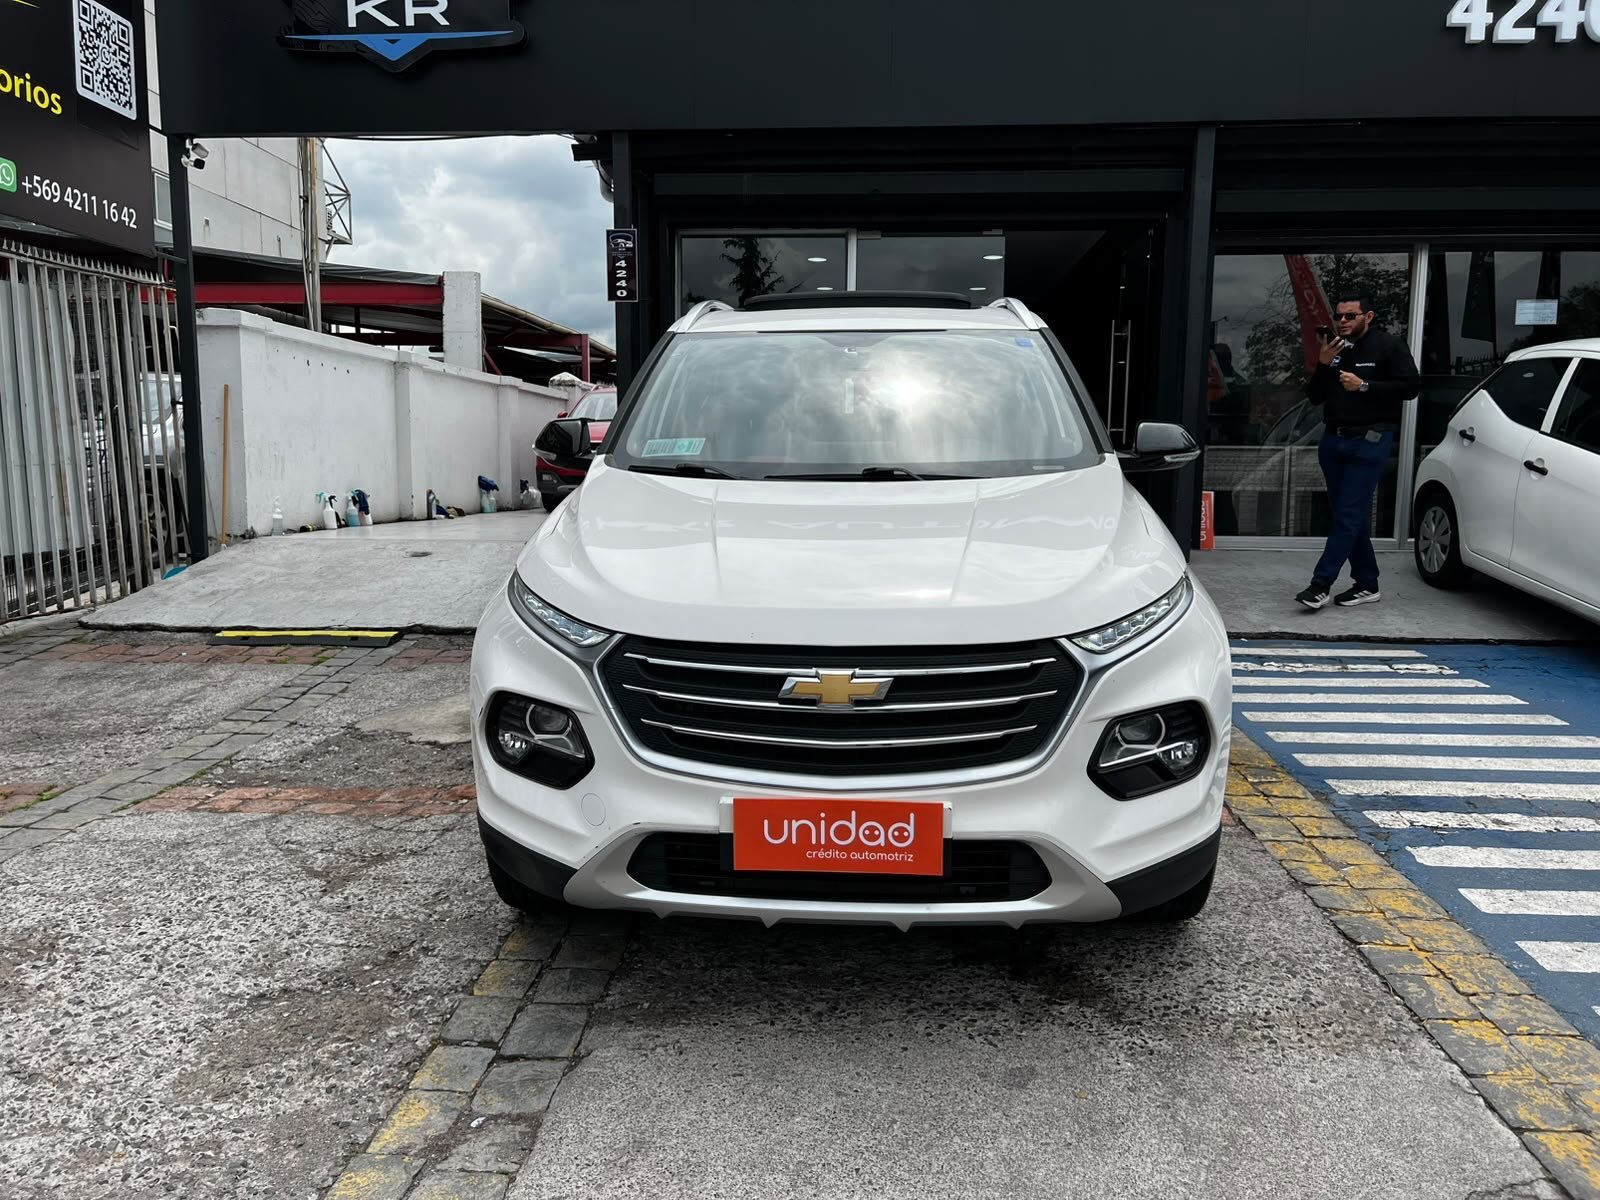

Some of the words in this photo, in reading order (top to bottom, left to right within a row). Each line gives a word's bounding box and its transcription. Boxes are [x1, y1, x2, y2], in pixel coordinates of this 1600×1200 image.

[22, 175, 61, 203] +569
[64, 187, 97, 216] 4211
[615, 259, 628, 297] 4240
[763, 810, 915, 847] unidad
[806, 848, 847, 859] crédito
[850, 850, 914, 862] automotriz
